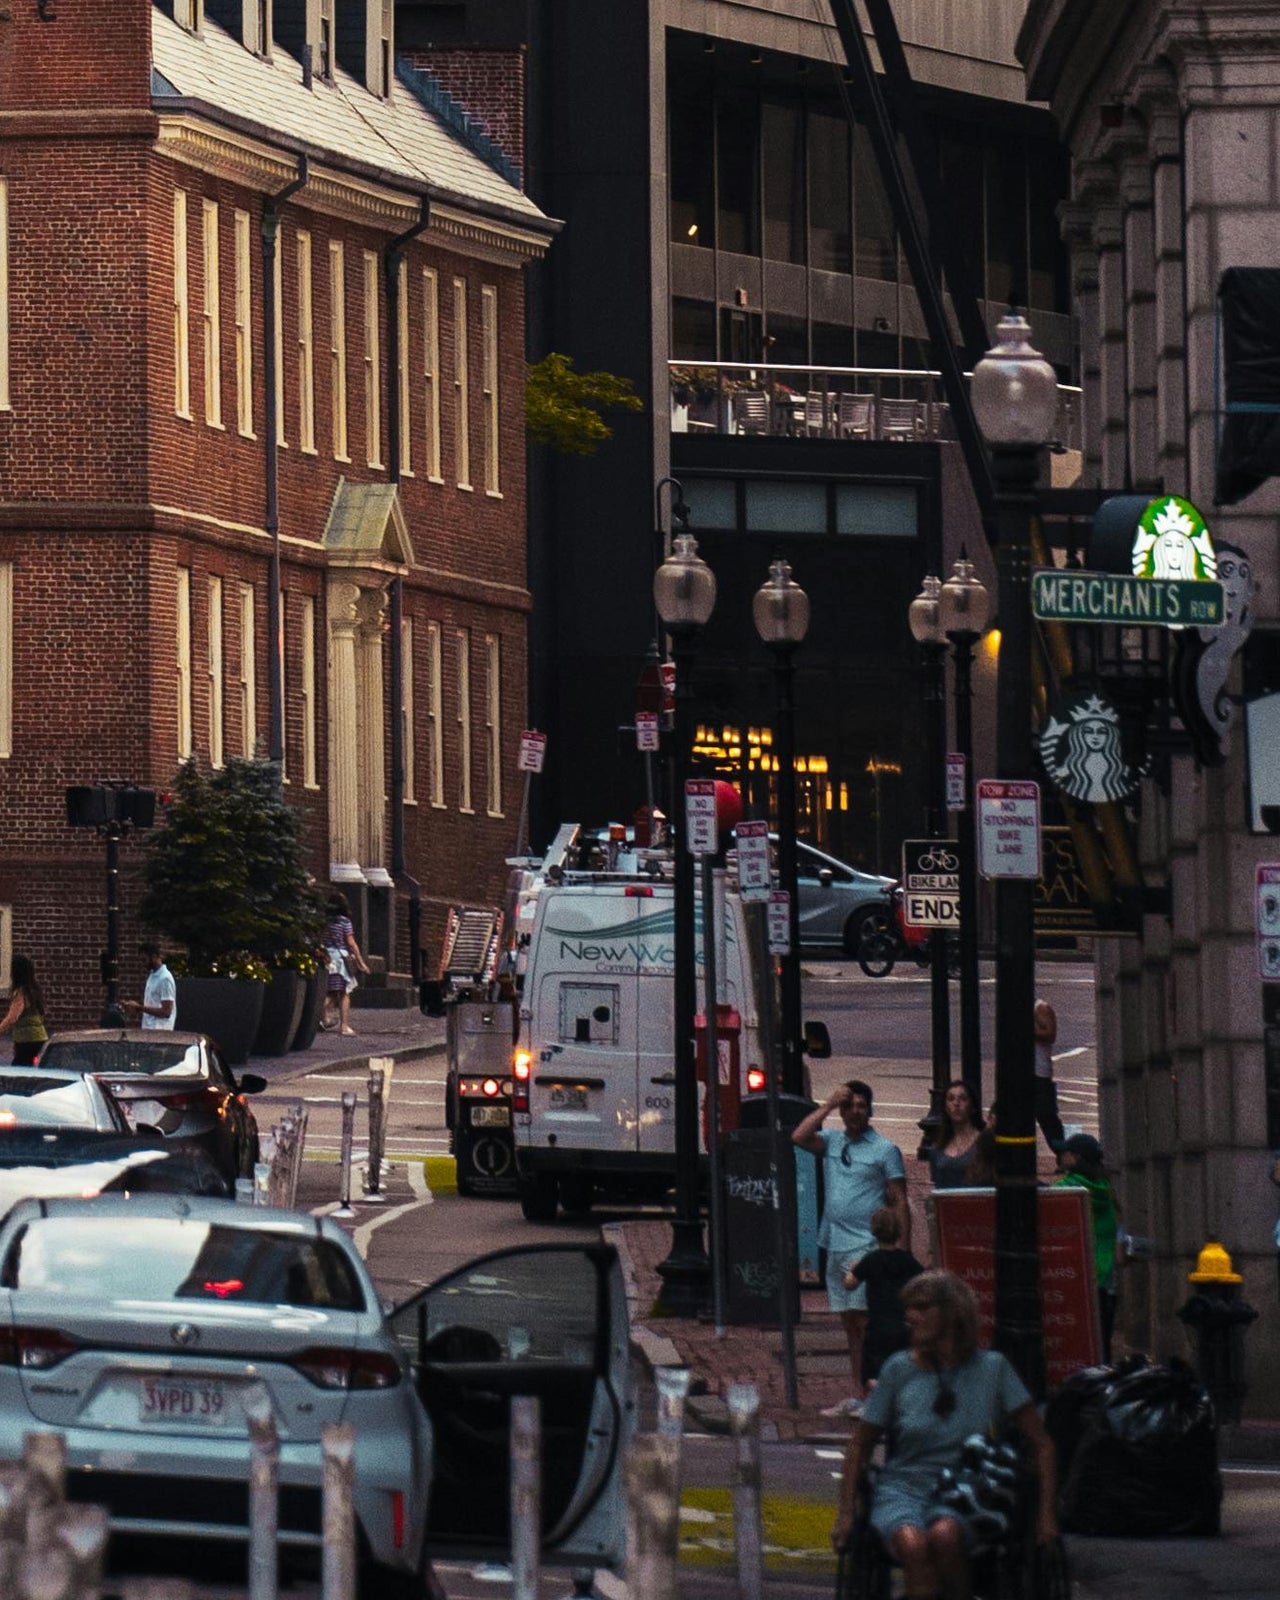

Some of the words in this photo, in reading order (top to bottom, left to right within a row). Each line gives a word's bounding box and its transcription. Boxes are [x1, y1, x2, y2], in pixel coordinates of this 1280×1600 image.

[1040, 578, 1180, 618] MERCHANTS
[1191, 601, 1216, 619] ROW
[1000, 801, 1016, 812] NO
[984, 815, 1035, 826] STOPPING
[911, 876, 935, 888] BIKE
[645, 1096, 670, 1109] 603
[200, 1391, 224, 1414] 39
